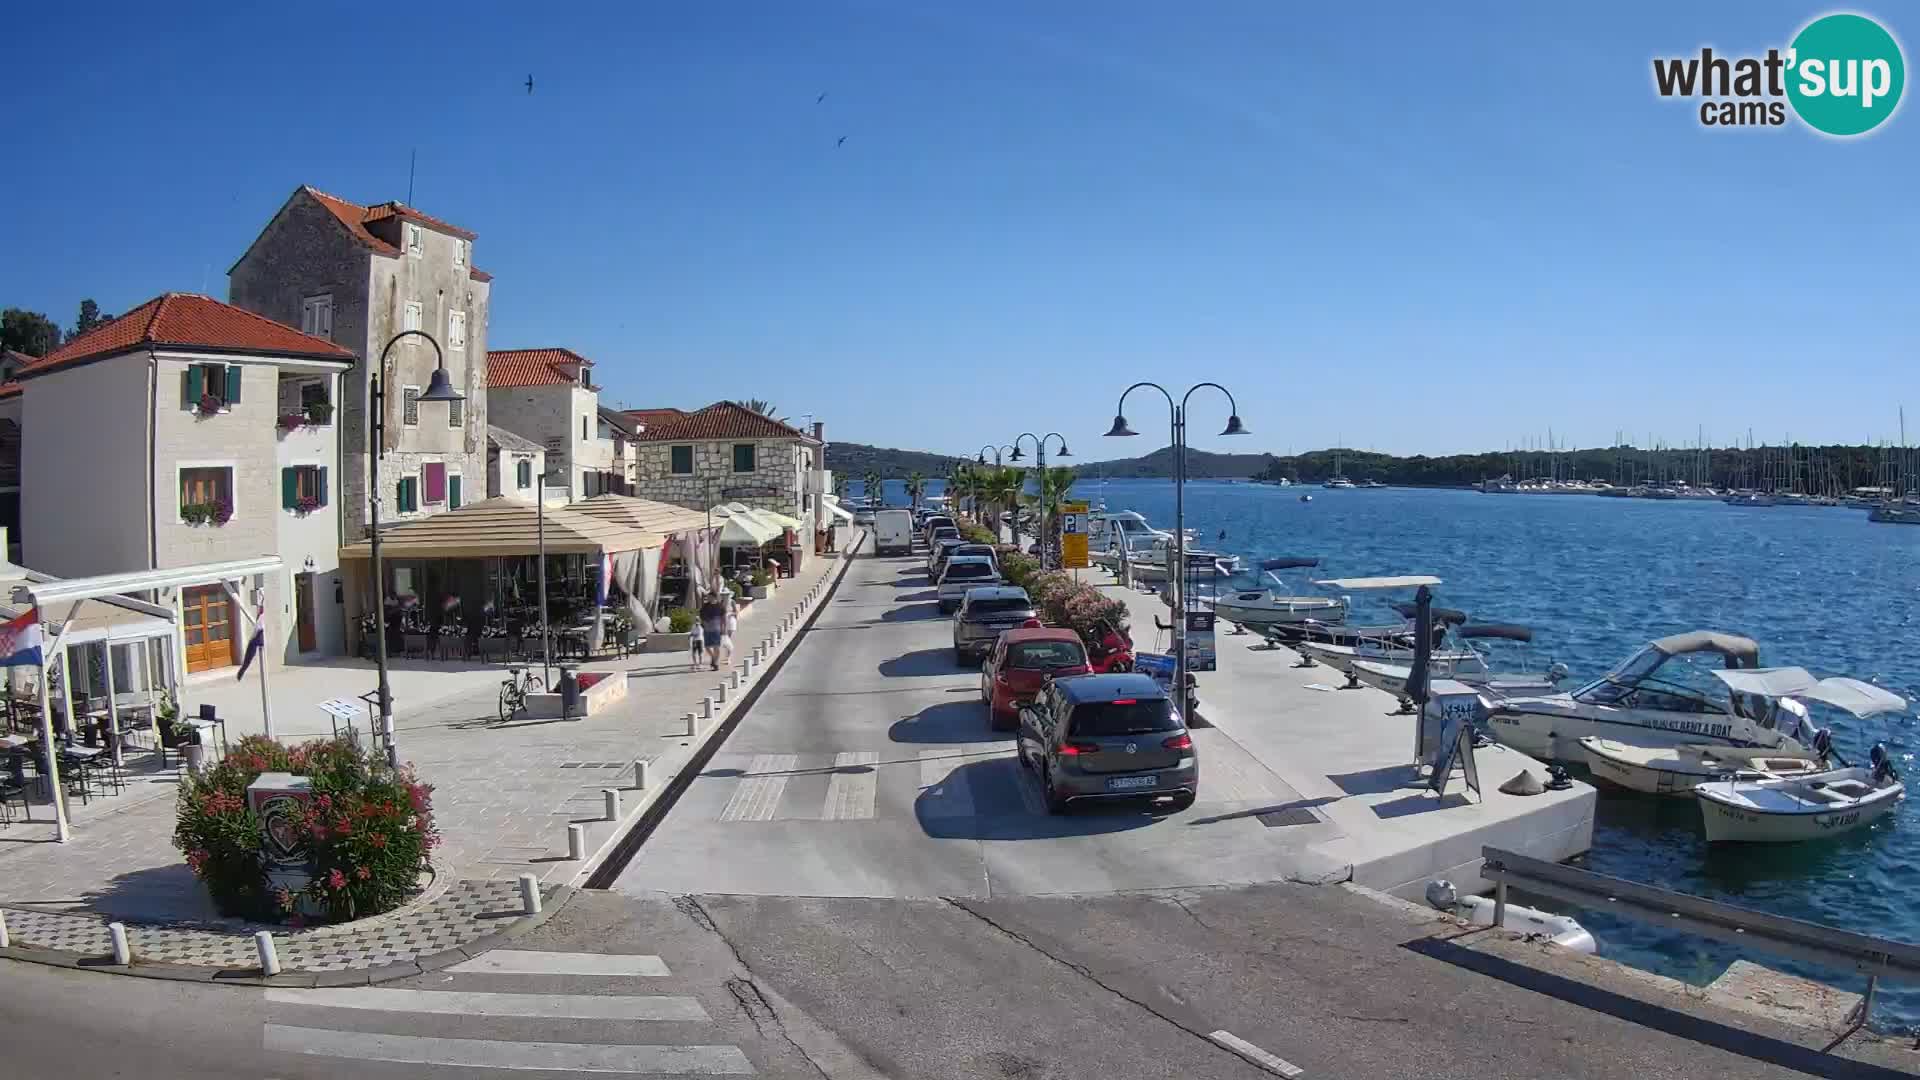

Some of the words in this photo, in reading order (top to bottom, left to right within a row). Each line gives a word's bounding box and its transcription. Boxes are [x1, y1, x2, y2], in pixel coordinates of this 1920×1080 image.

[1065, 515, 1075, 531] P
[1680, 720, 1702, 733] RENT
[1711, 724, 1732, 736] BOAT
